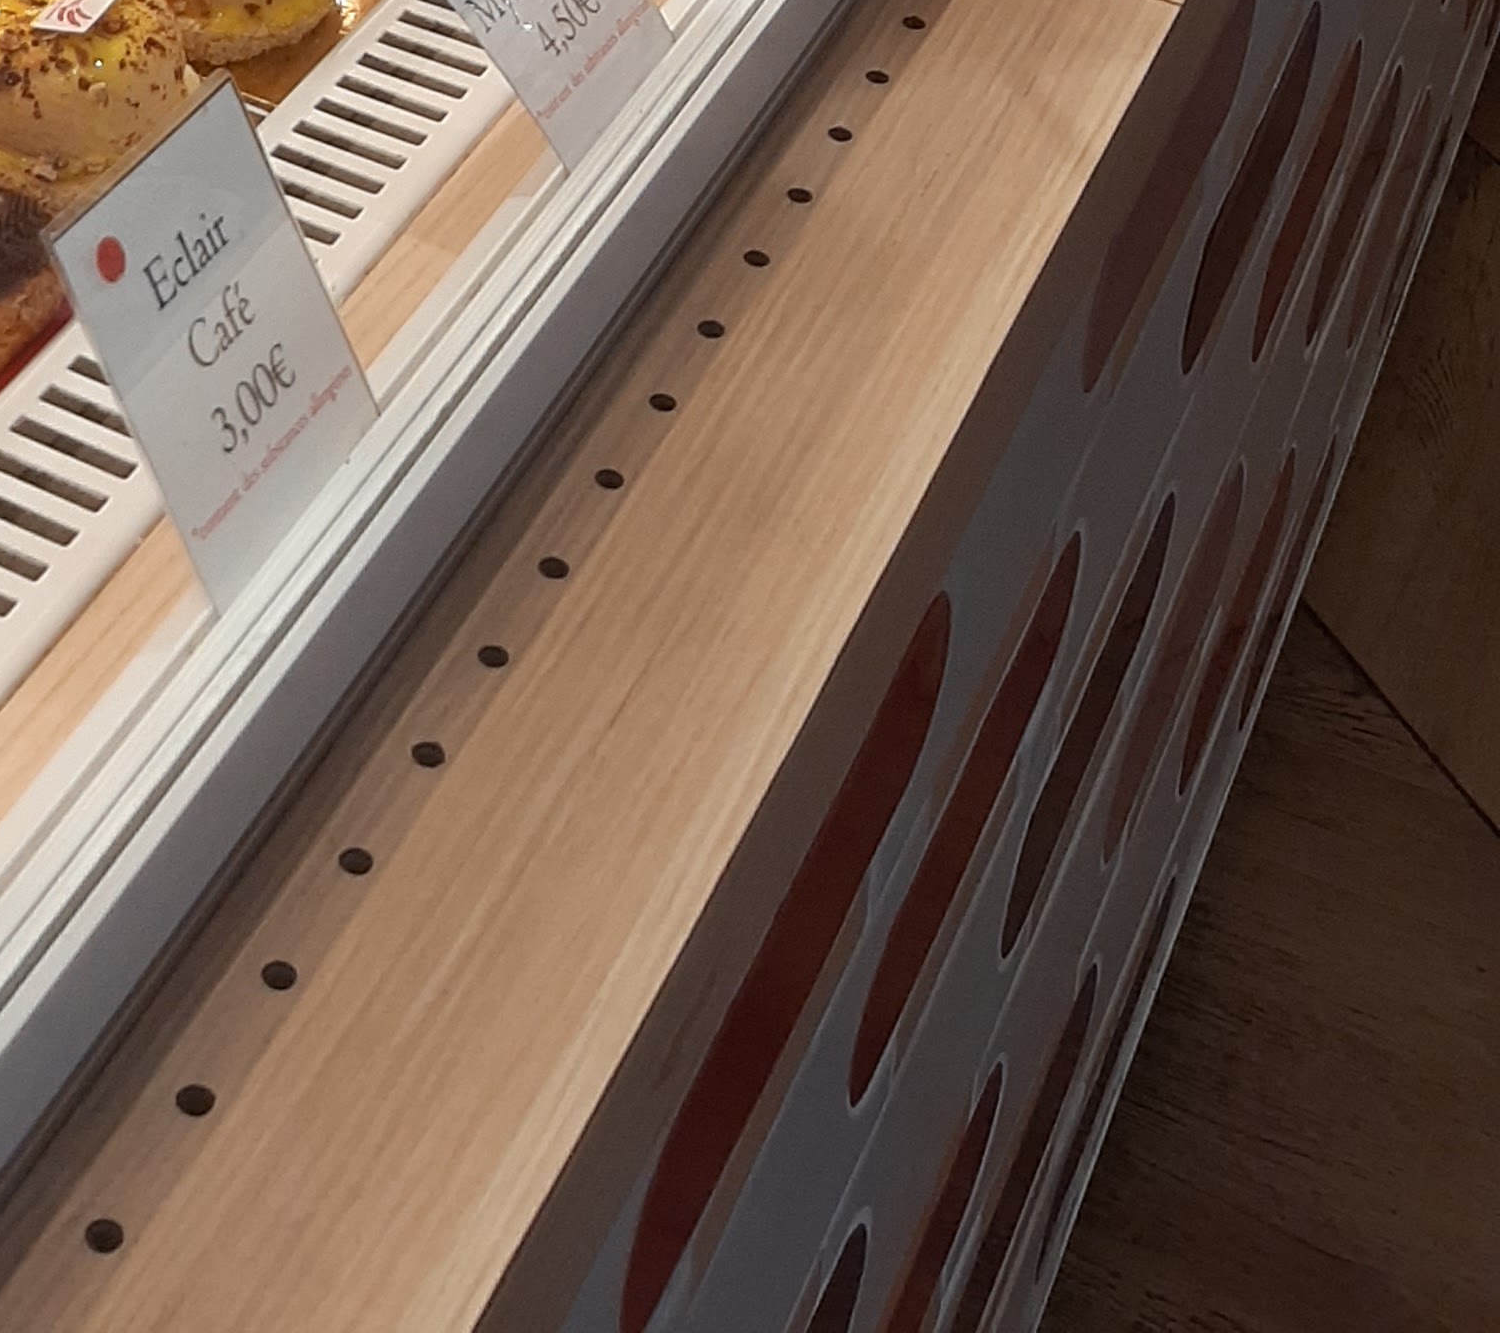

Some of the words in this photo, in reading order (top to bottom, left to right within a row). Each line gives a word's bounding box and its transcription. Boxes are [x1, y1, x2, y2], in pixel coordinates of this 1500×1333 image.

[141, 211, 232, 311] Eclair
[186, 282, 257, 369] Café
[210, 342, 296, 454] 3,00€
